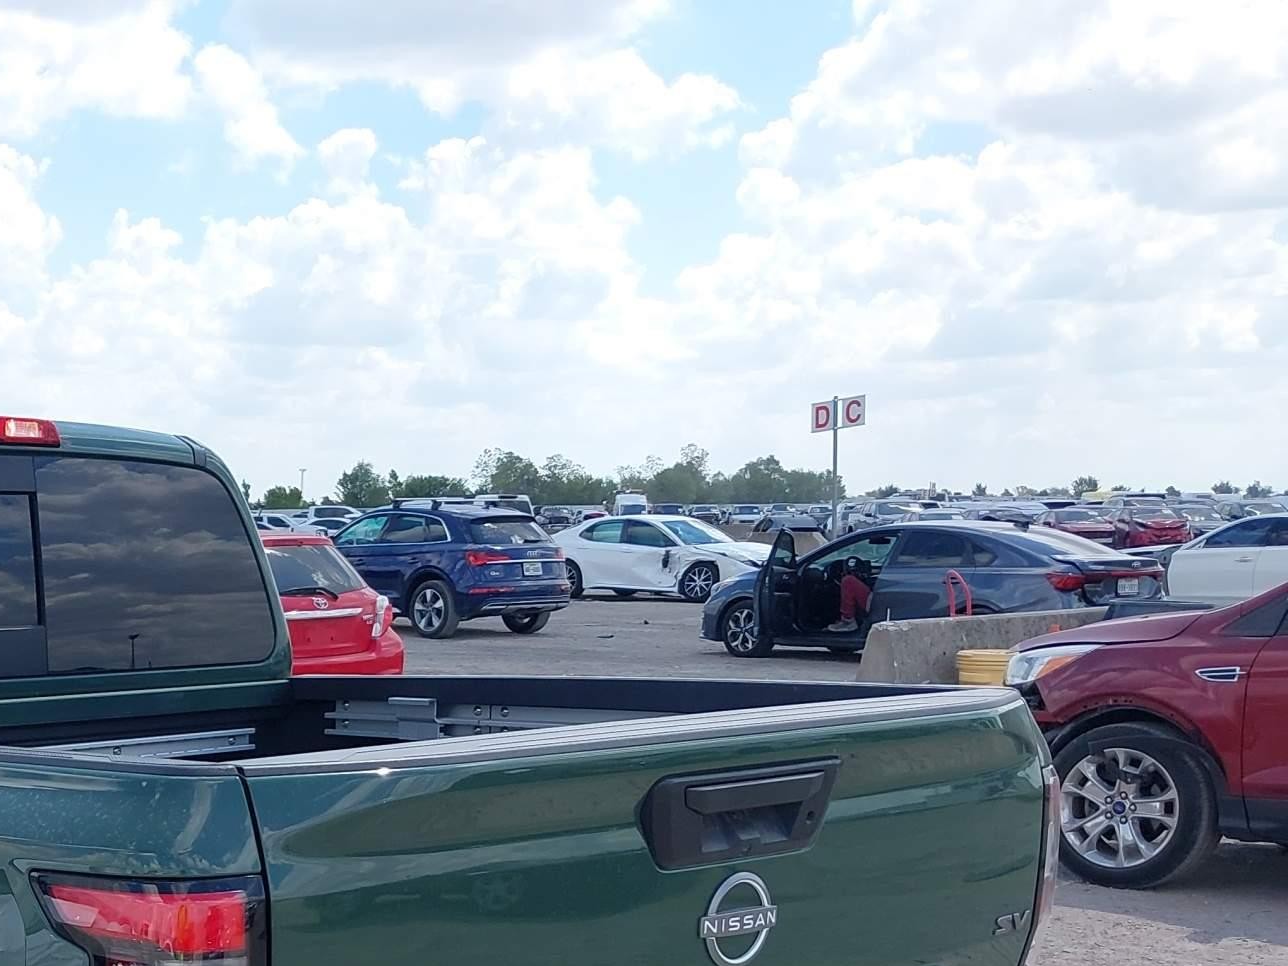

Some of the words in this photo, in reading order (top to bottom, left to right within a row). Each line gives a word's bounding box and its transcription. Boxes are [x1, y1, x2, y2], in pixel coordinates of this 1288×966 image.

[815, 405, 830, 429] D
[845, 399, 861, 424] C
[703, 909, 777, 935] NISSAN
[993, 909, 1031, 936] SV
